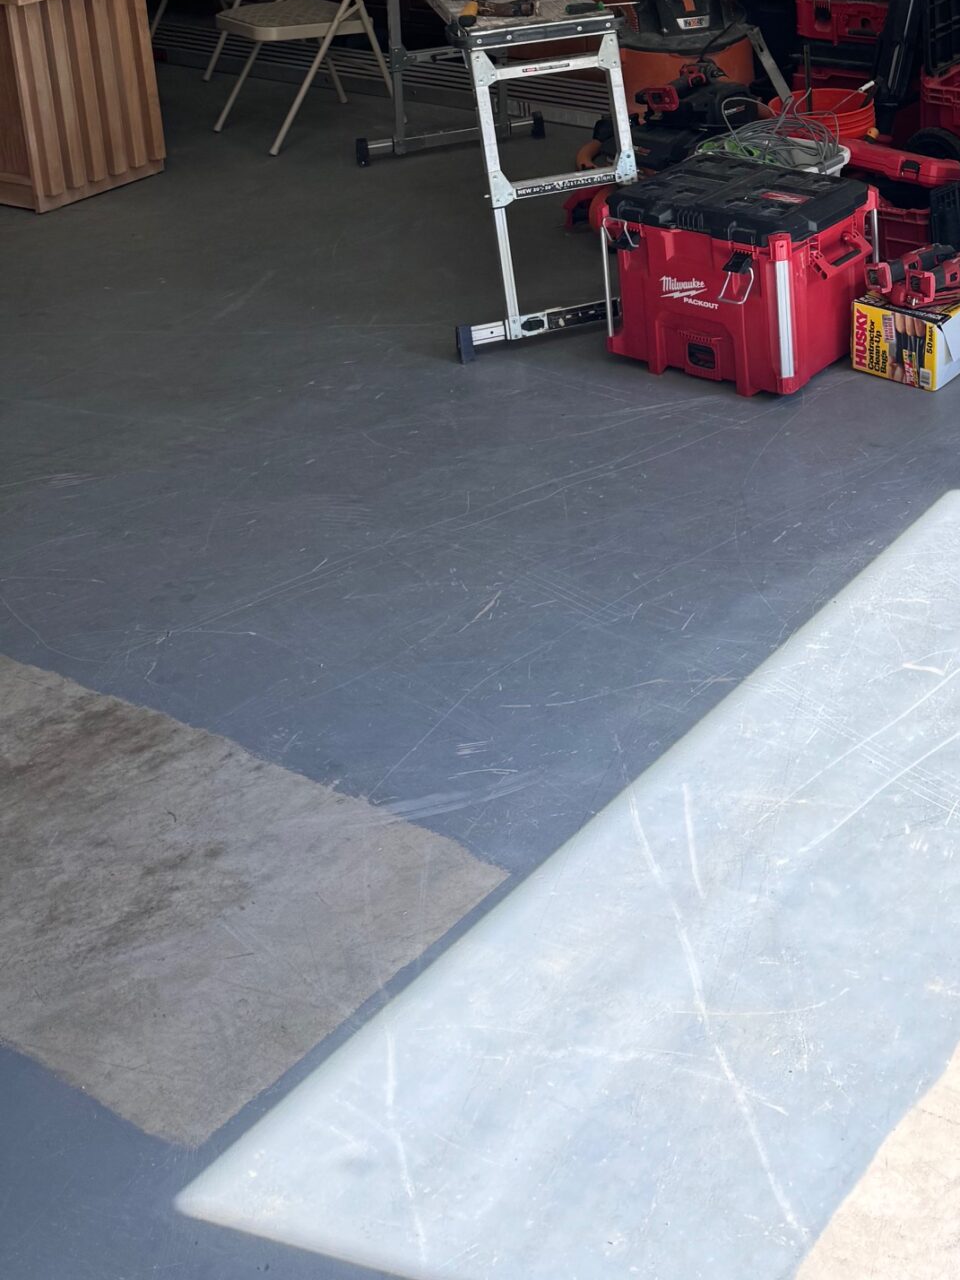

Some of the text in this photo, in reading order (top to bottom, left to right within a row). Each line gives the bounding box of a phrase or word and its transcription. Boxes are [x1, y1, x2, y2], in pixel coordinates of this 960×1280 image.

[659, 275, 706, 293] Milwaukee
[683, 296, 719, 310] PACKOUT
[855, 308, 868, 368] HUSKY
[867, 320, 875, 370] Contractor
[926, 342, 933, 354] 50
[880, 350, 888, 373] Bags
